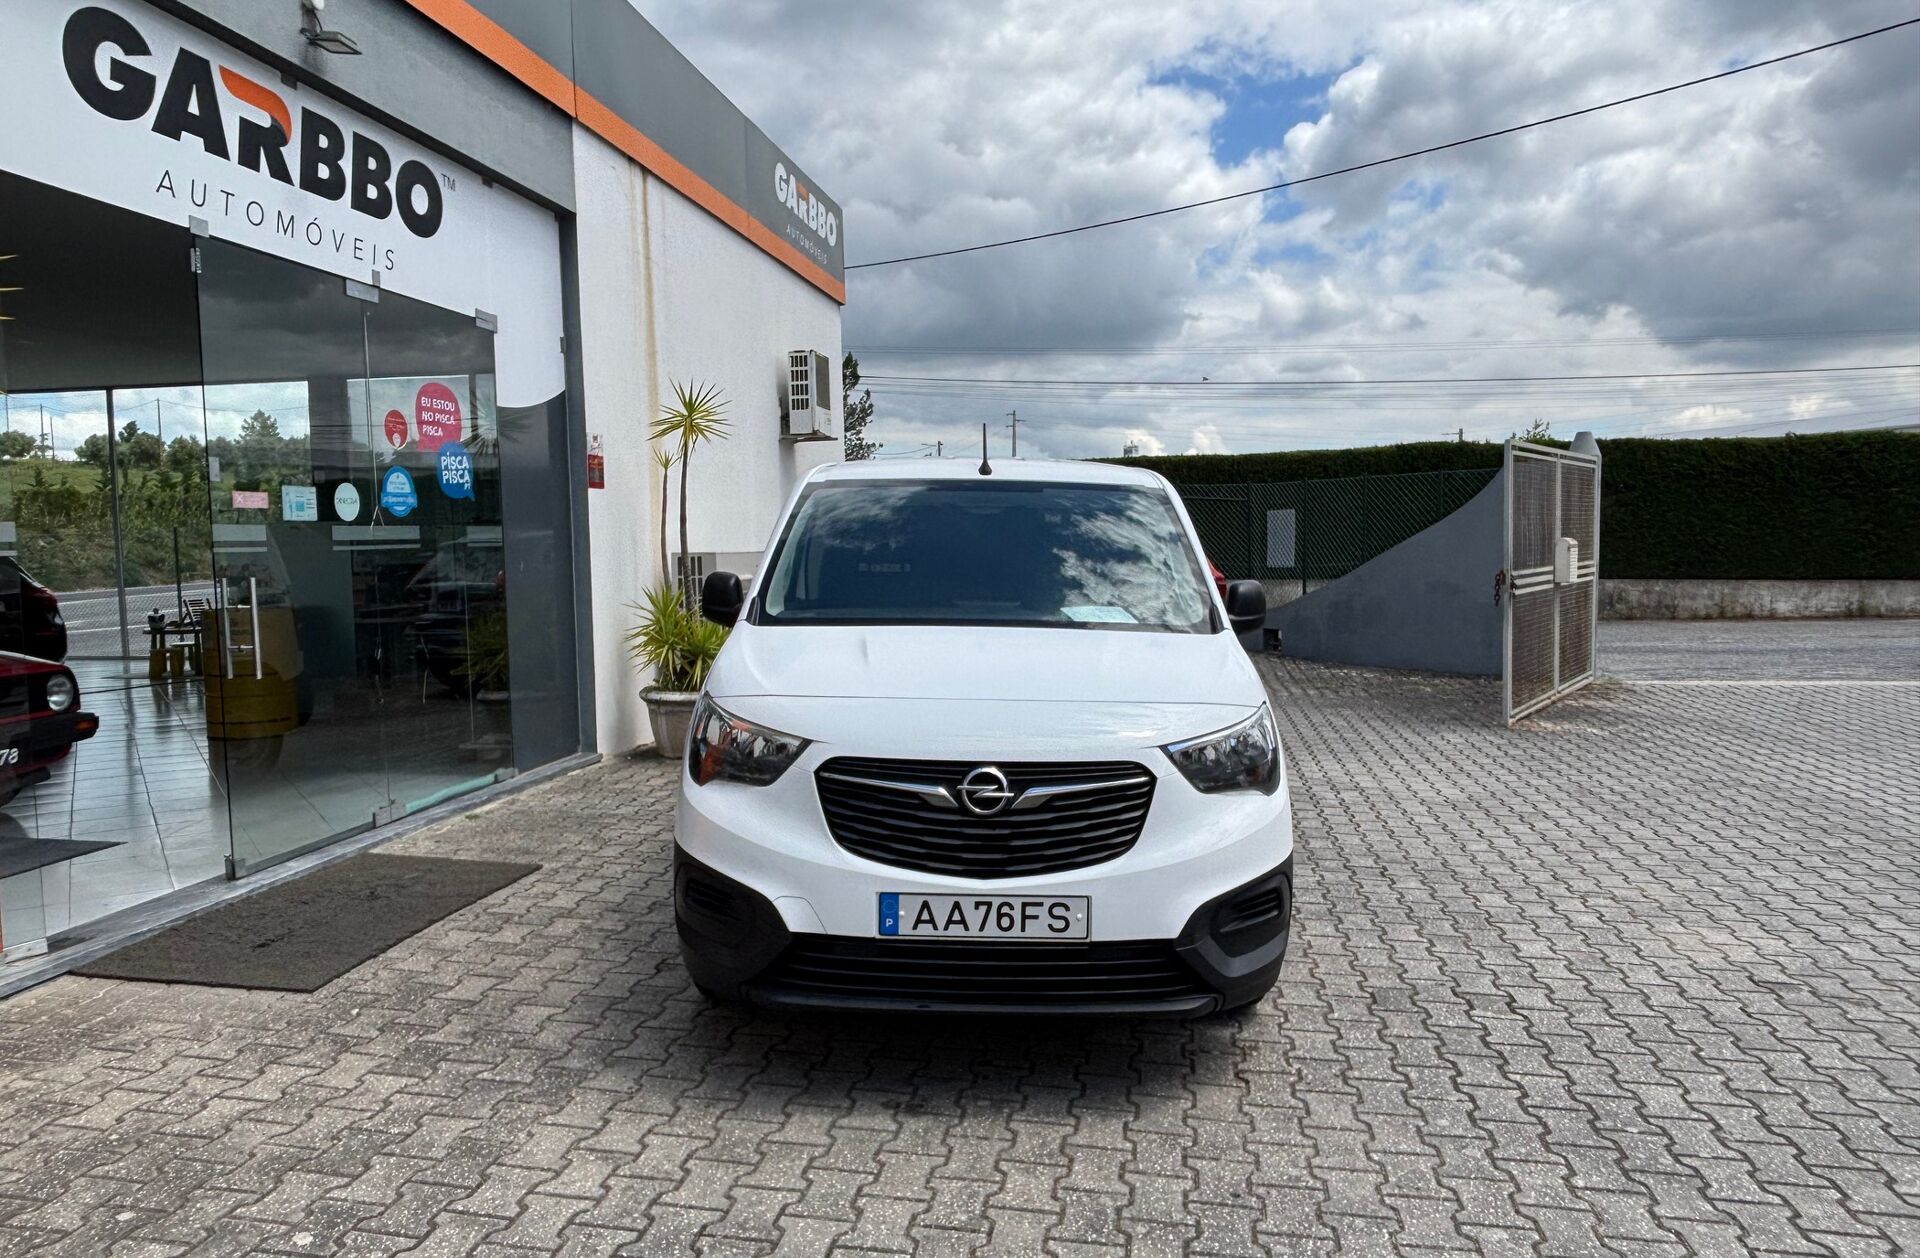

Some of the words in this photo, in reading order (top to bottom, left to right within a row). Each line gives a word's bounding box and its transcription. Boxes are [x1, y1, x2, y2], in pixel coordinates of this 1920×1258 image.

[62, 6, 443, 239] GARBBO
[774, 162, 837, 247] GARBBO
[156, 170, 396, 272] AUTOMÓVEIS
[421, 396, 431, 407] EU
[432, 398, 455, 412] ESTOU
[421, 410, 434, 422] NO
[434, 412, 456, 425] PISCA
[422, 424, 444, 437] PISCA
[442, 469, 471, 484] PISCA
[885, 918, 893, 928] P
[911, 899, 1071, 933] AA76FS
